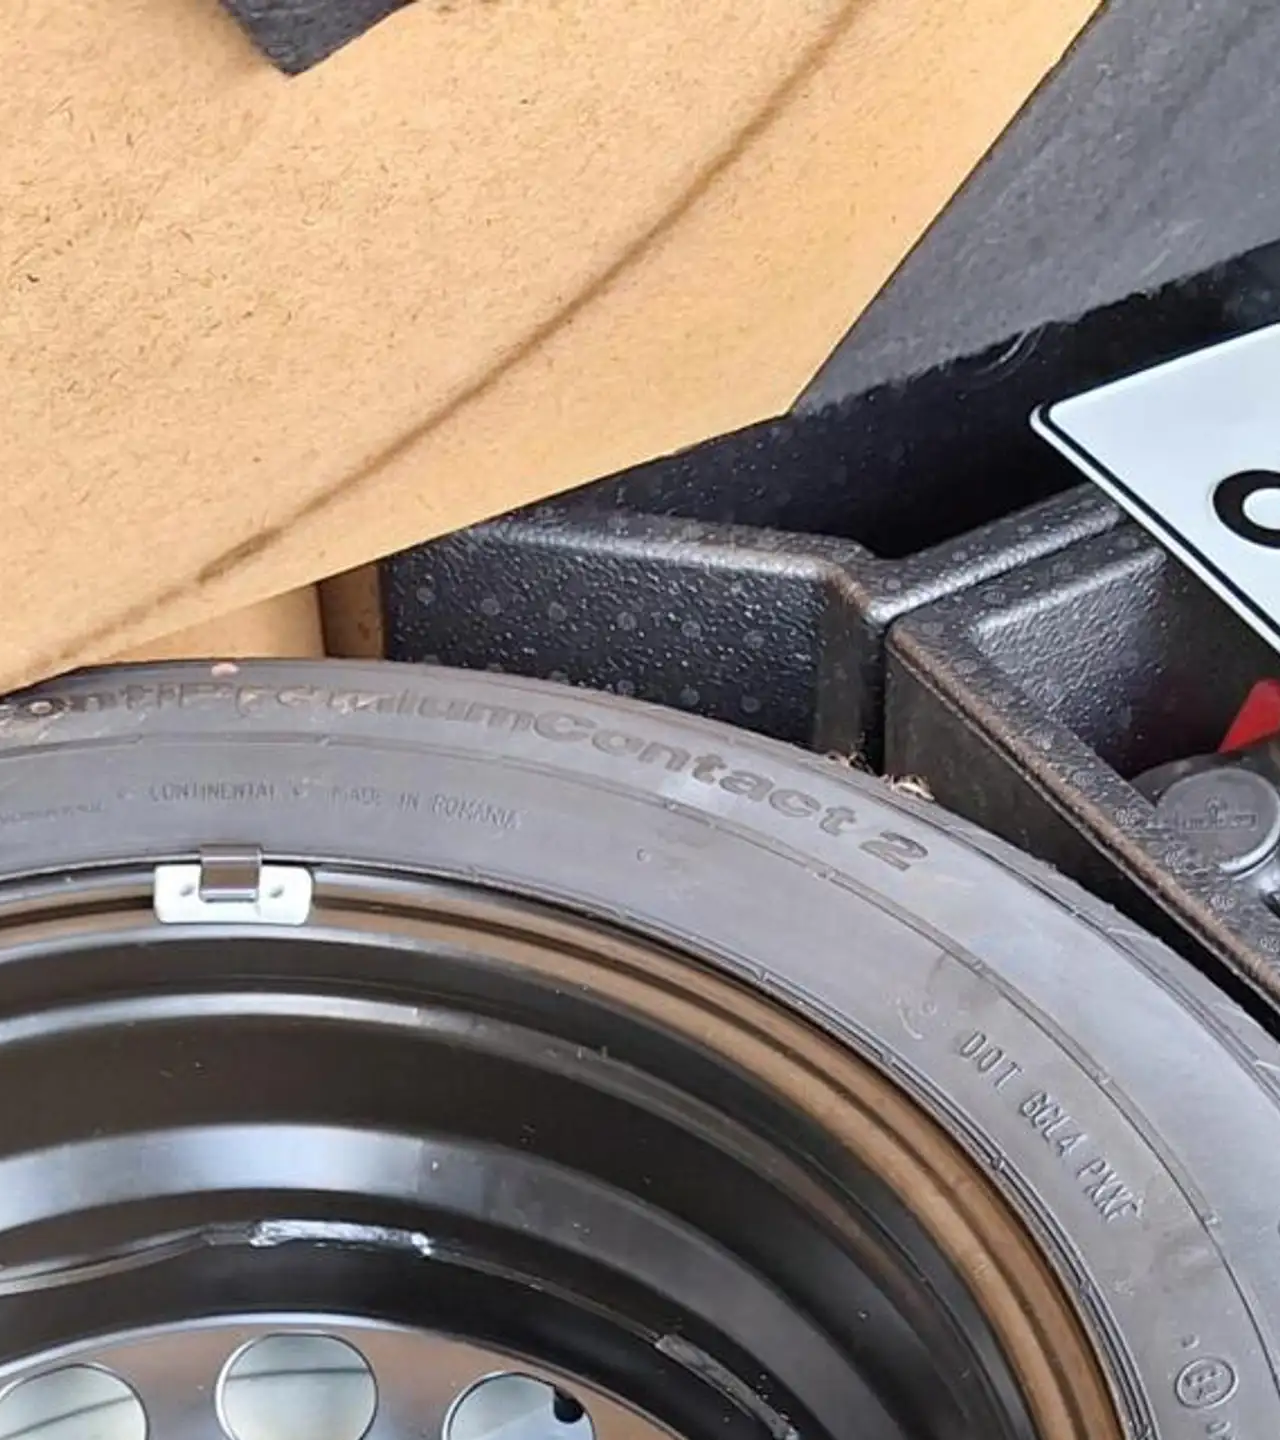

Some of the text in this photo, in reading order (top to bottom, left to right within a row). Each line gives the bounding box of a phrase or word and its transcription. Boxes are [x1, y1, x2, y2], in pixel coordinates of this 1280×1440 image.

[149, 783, 523, 830] CONTINENTAL MADE IN ROMANIA
[859, 830, 930, 872] 2
[957, 1030, 1025, 1091] DOT
